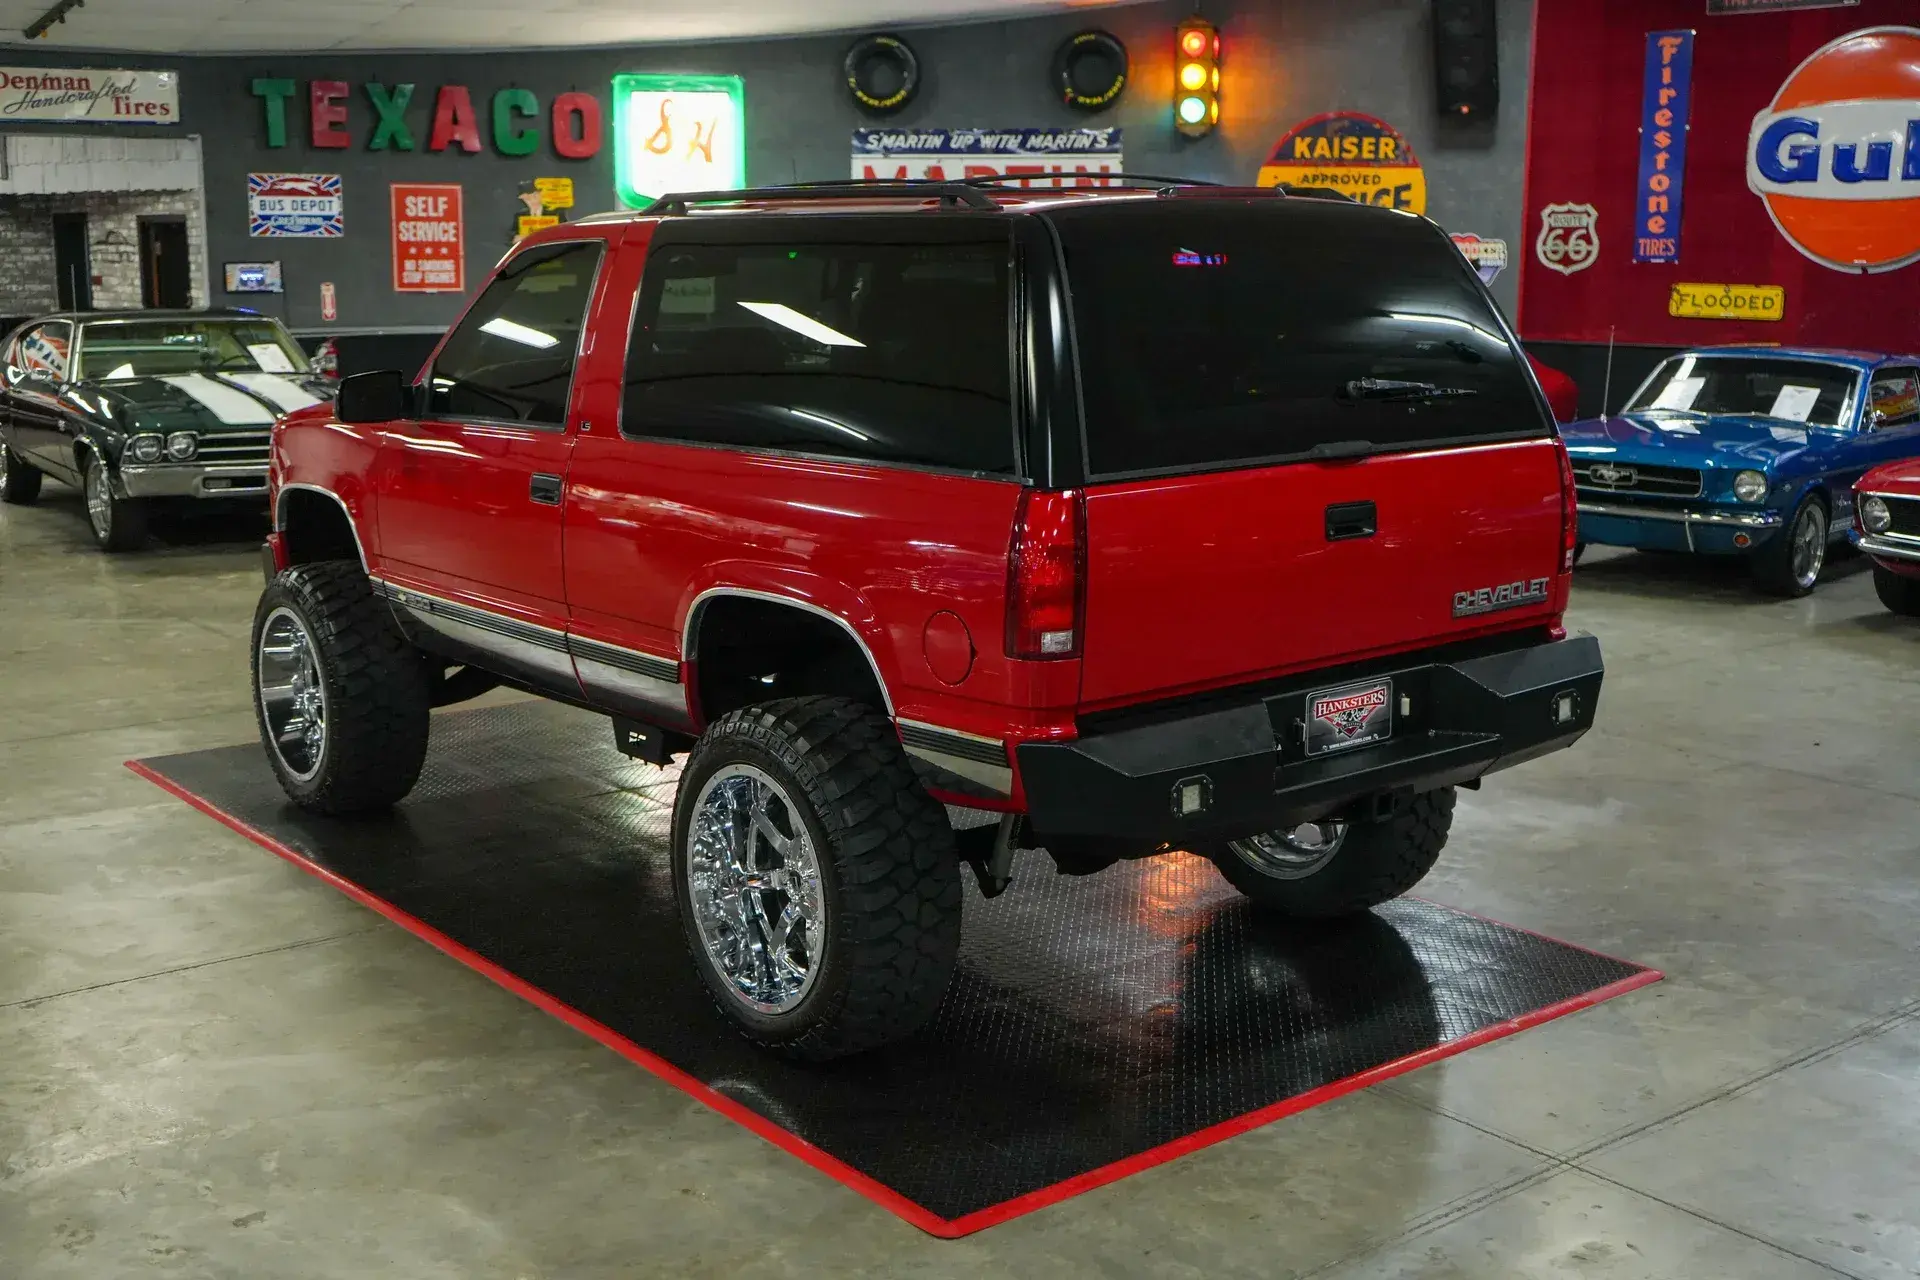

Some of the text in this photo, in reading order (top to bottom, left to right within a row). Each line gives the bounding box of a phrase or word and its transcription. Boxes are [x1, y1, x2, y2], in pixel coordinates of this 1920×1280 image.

[3, 73, 138, 116] Handcrafted
[111, 95, 170, 116] Tires
[252, 78, 602, 158] TEXACO
[949, 134, 976, 149] UP
[979, 133, 1021, 149] WITH
[1647, 36, 1684, 234] Firestone
[1294, 136, 1397, 160] KAISER
[1301, 174, 1382, 185] APPROVED
[259, 200, 334, 211] BUS DEPOT
[404, 195, 449, 217] SELF
[398, 220, 458, 242] SERVICE
[1546, 228, 1588, 261] 66
[1638, 238, 1676, 256] TIRES
[1679, 293, 1775, 310] FLOODED
[1454, 577, 1549, 609] CHEVROLET
[1317, 690, 1385, 716] HANKSTERS
